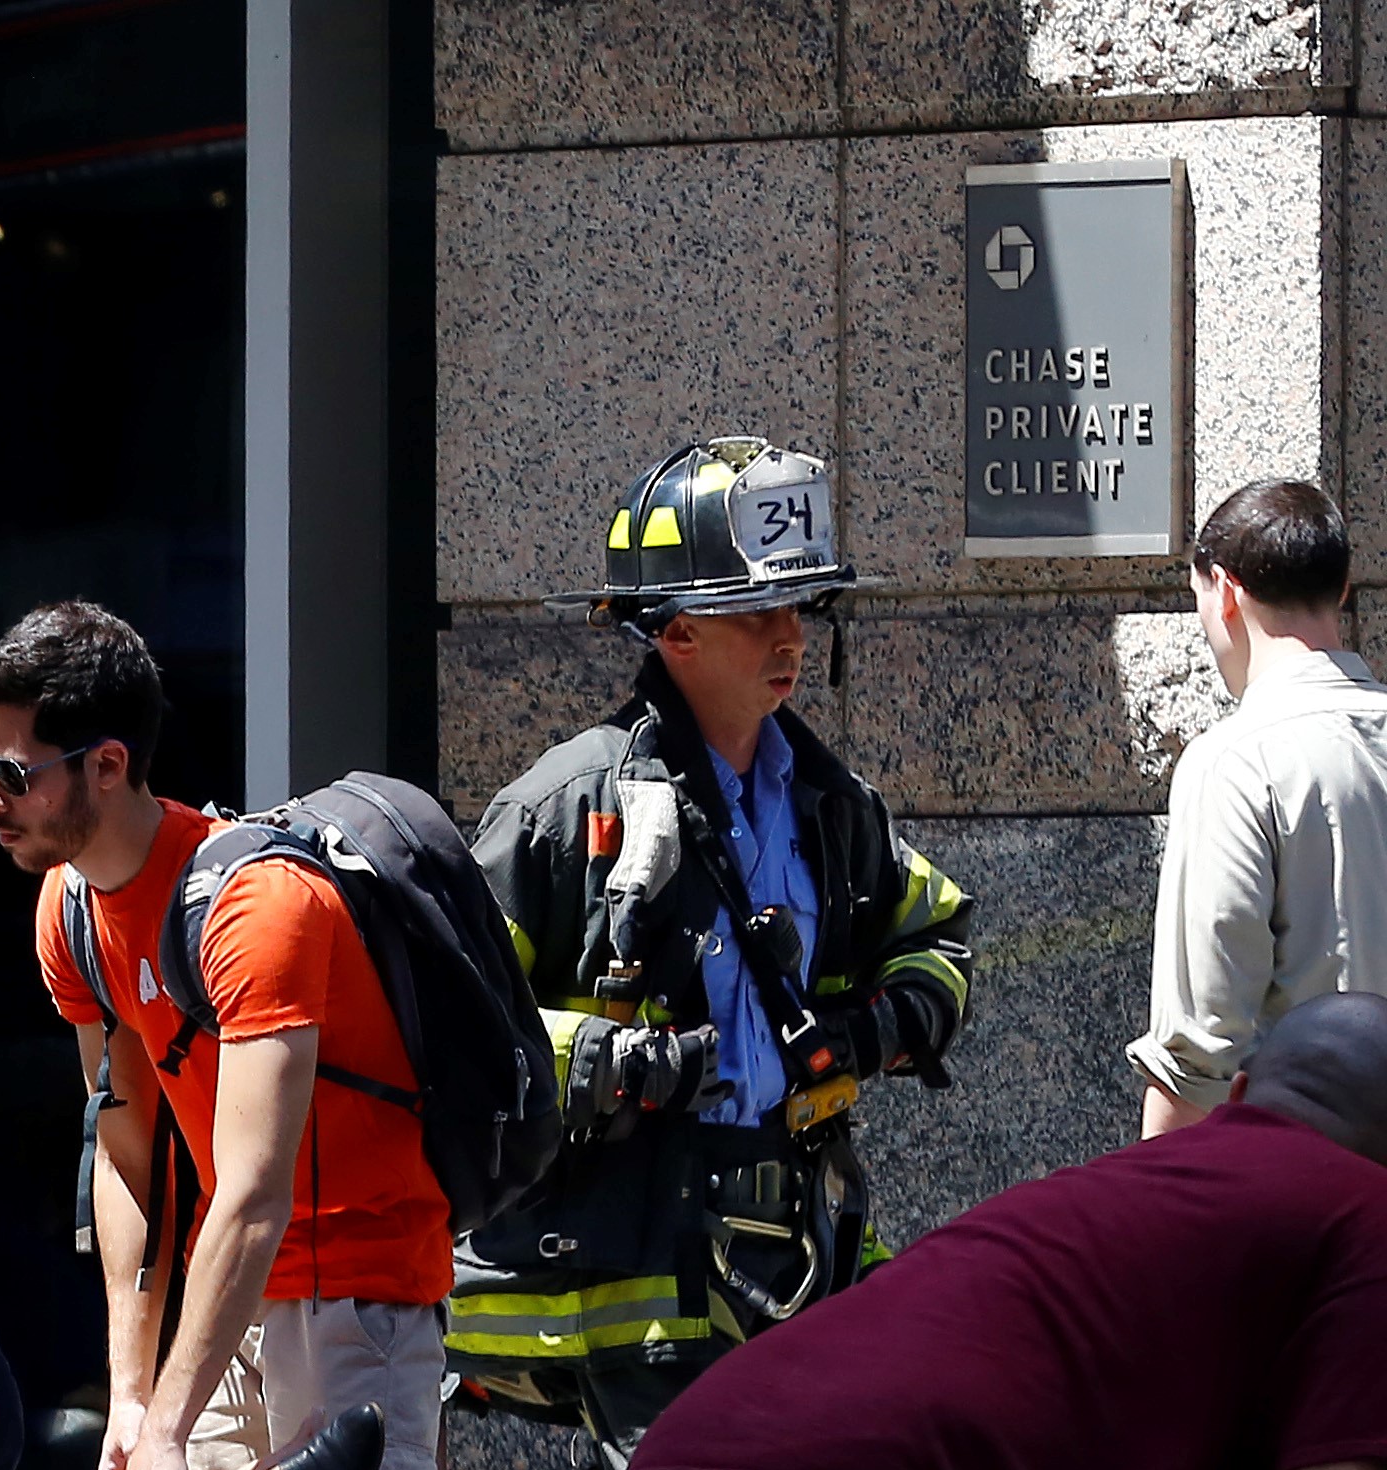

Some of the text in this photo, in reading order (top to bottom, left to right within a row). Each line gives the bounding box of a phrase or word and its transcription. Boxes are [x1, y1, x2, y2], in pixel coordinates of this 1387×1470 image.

[984, 347, 1109, 387] CHASE
[984, 403, 1152, 444] PRIVATE
[983, 458, 1124, 499] CLIENT
[757, 493, 812, 545] 34
